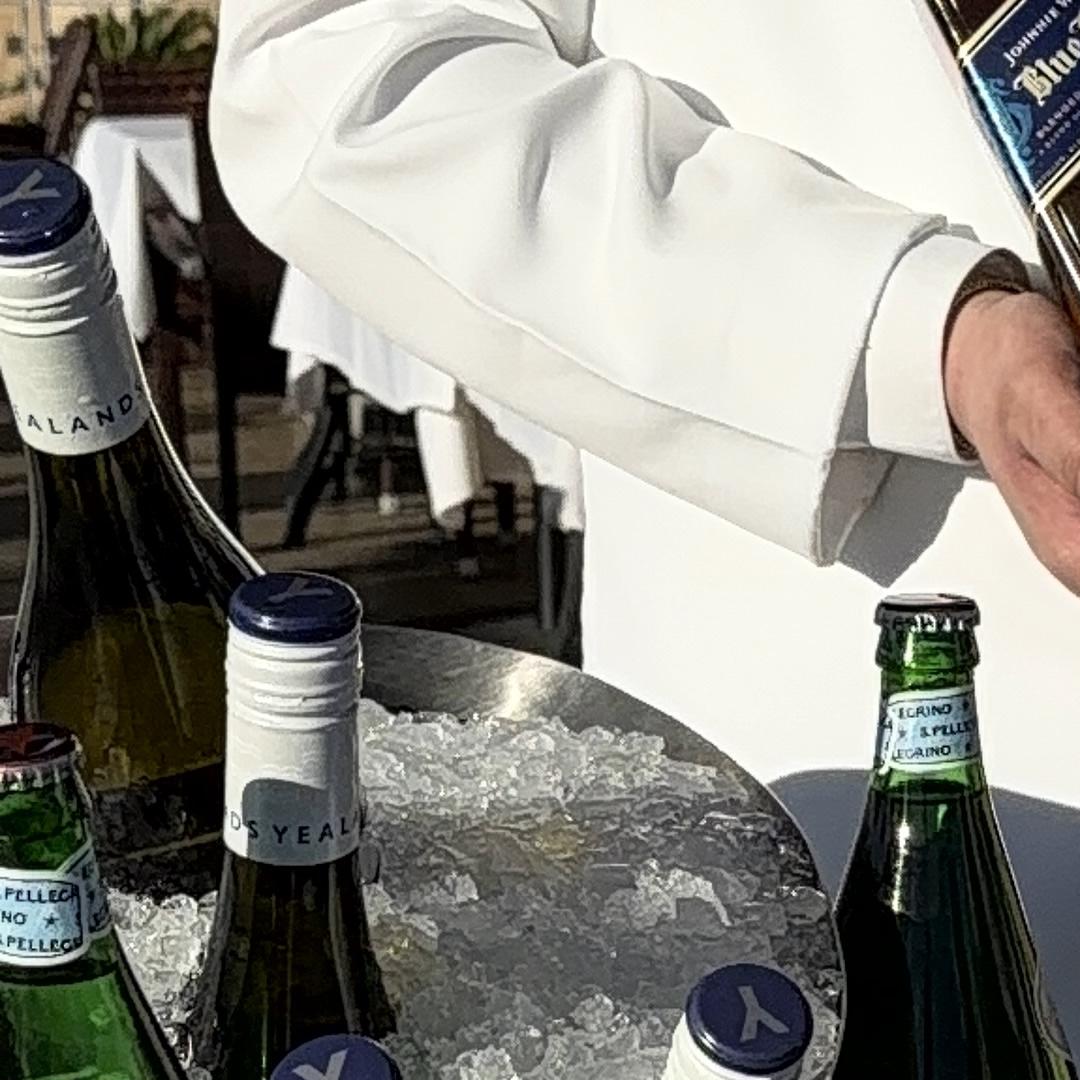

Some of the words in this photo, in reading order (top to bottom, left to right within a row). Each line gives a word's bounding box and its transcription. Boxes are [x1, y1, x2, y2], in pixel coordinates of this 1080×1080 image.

[1003, 7, 1060, 68] JOHNNIE
[0, 169, 62, 209] Y
[19, 385, 142, 434] ALAND
[272, 816, 350, 845] YEAL
[737, 985, 790, 1044] Y
